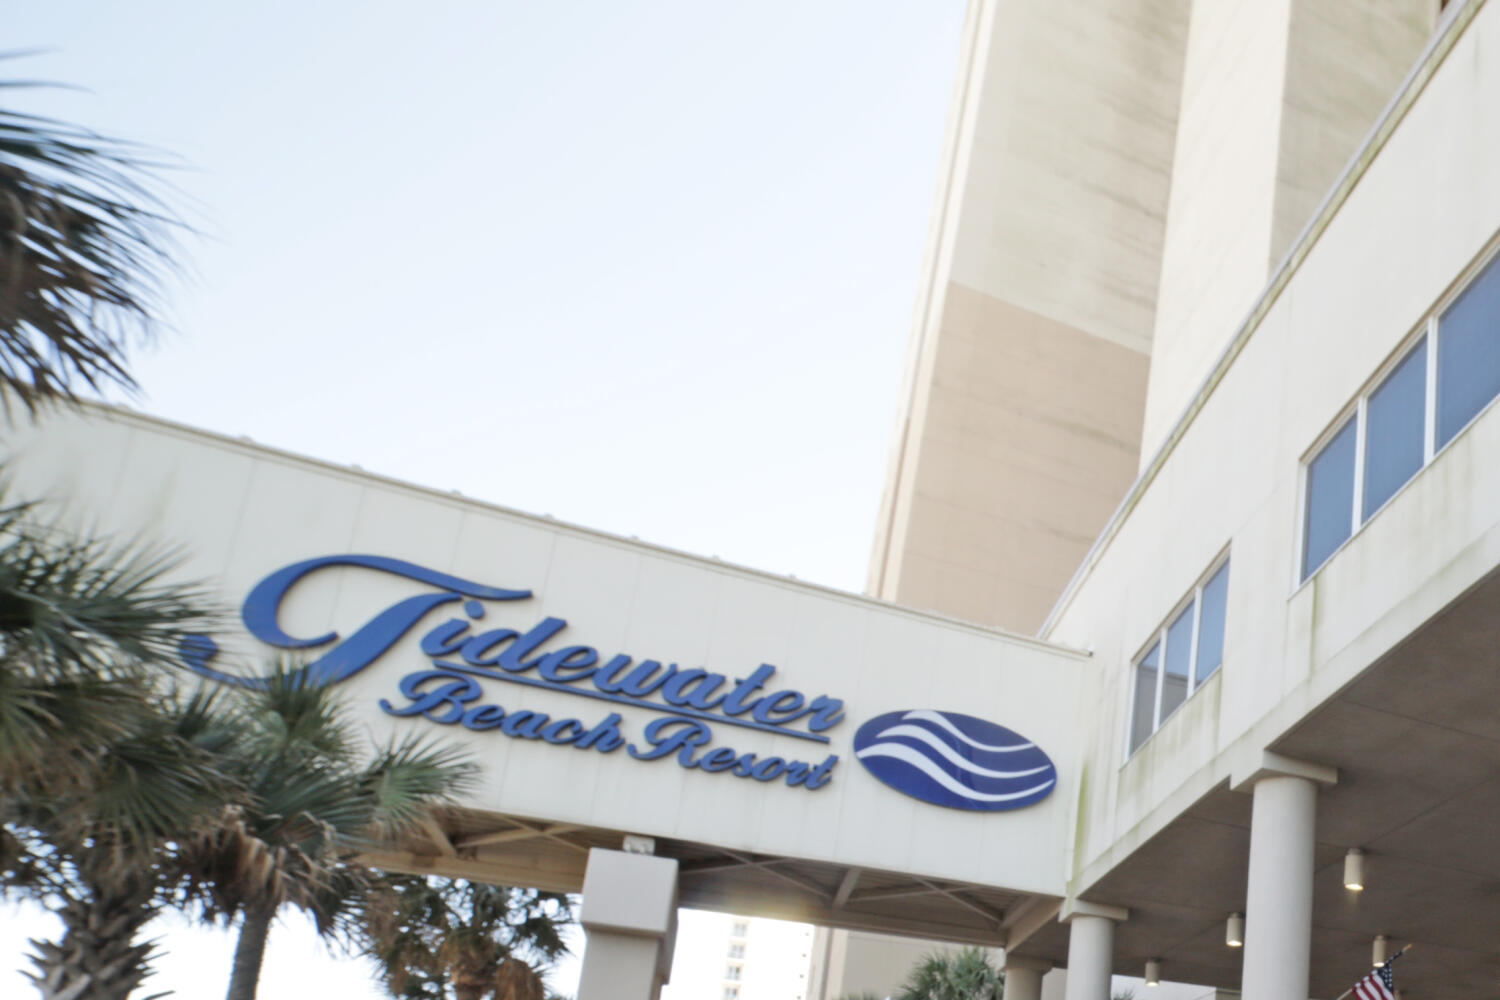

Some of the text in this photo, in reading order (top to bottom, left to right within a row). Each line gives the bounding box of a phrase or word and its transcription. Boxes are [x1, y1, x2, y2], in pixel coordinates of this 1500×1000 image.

[178, 554, 846, 732] Tidewater
[379, 670, 839, 791] Beach Resort
